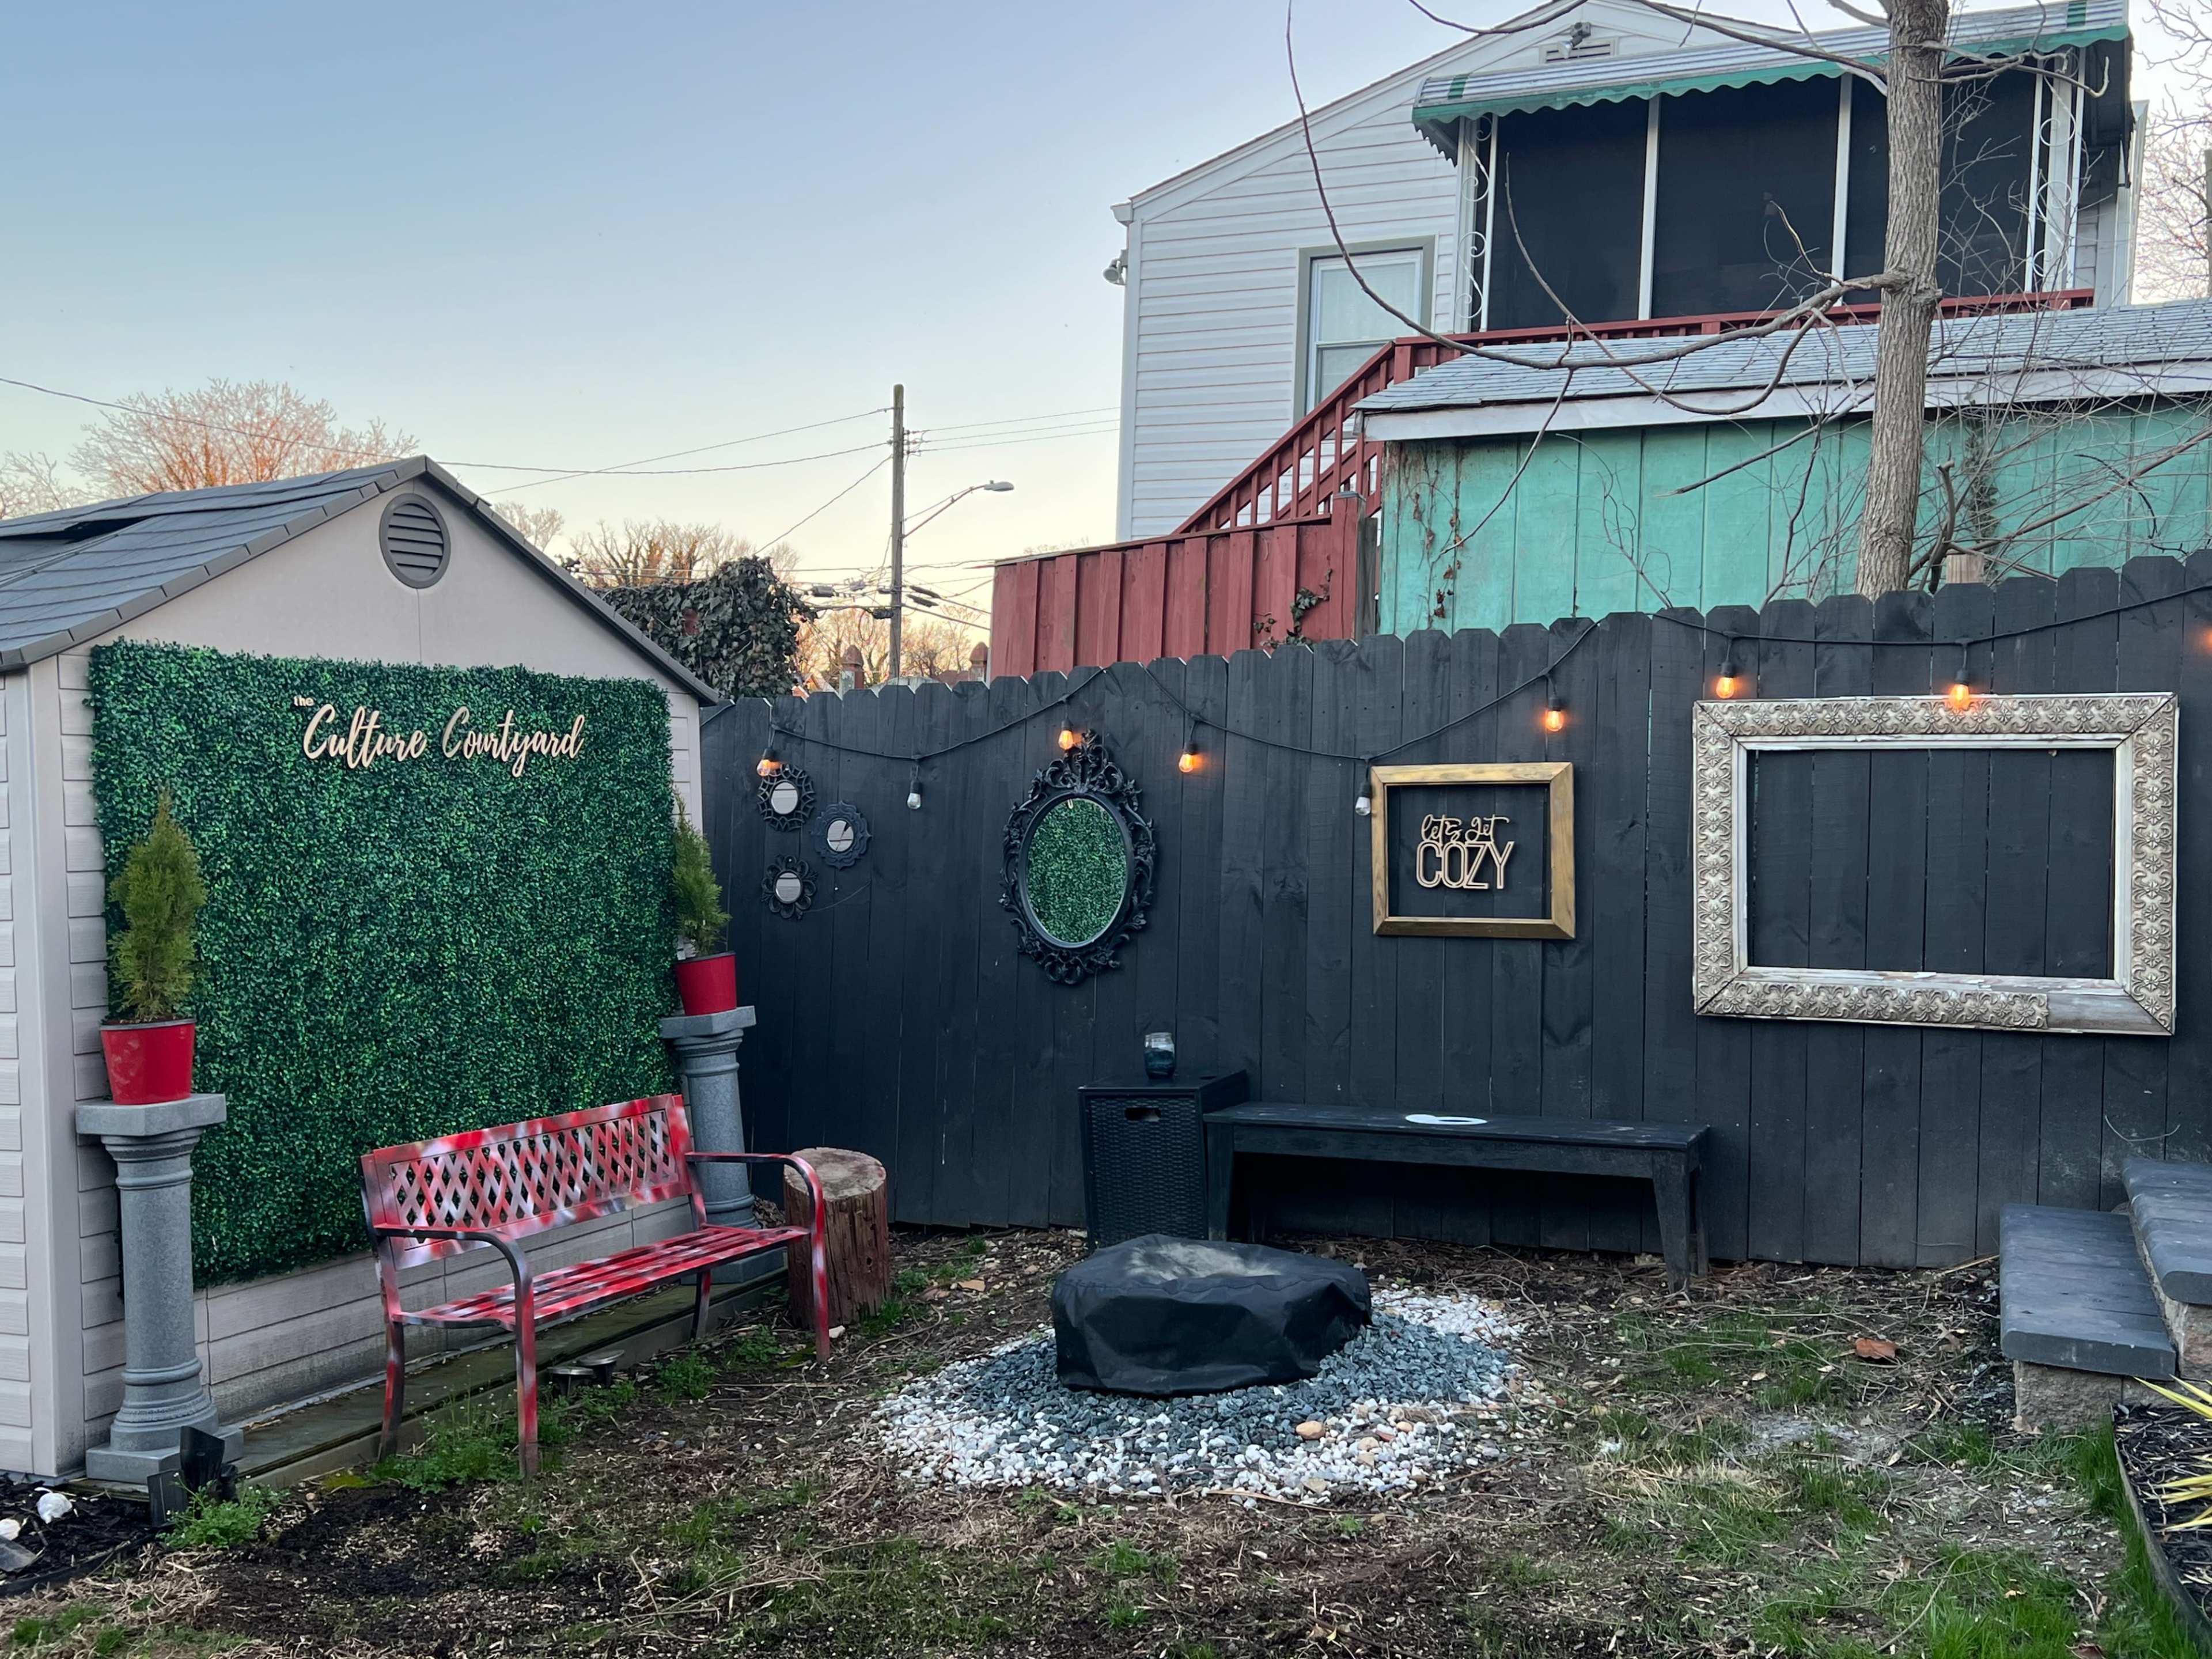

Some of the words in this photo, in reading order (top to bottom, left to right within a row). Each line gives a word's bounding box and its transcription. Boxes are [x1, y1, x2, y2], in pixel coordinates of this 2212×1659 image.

[294, 695, 314, 706] the
[303, 704, 426, 769] Culture
[442, 706, 585, 778] Courtyard
[1465, 814, 1510, 842] get
[1416, 840, 1515, 889] COZY
